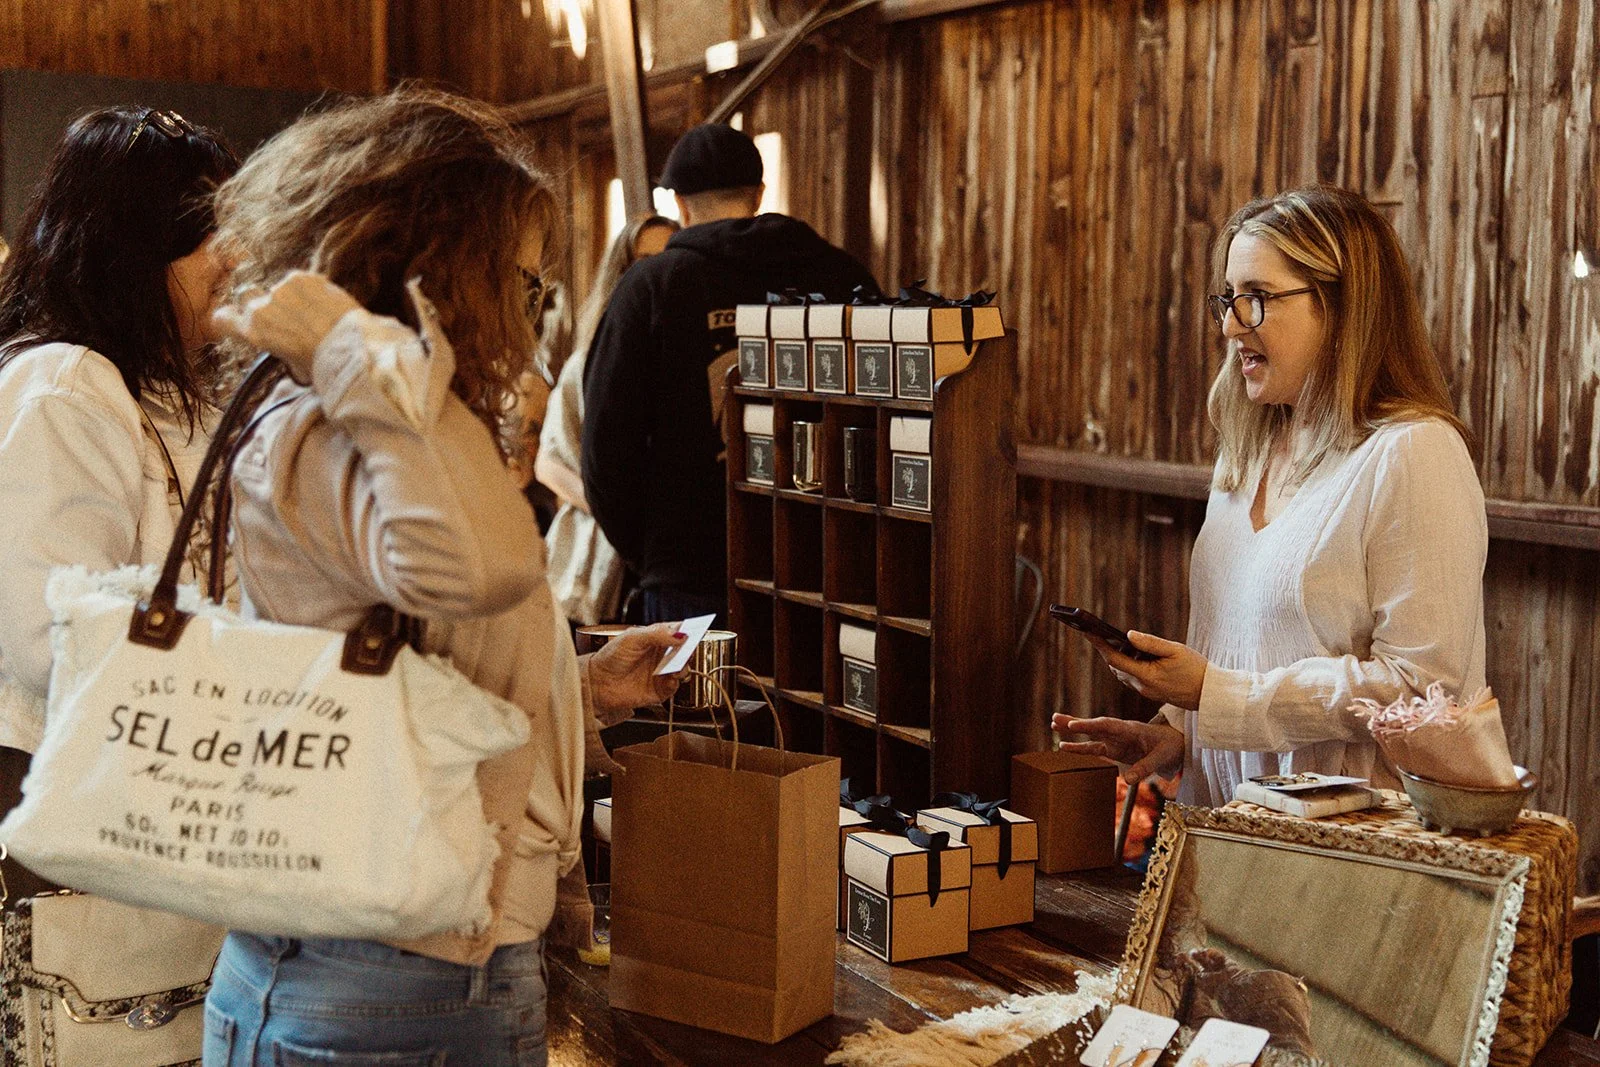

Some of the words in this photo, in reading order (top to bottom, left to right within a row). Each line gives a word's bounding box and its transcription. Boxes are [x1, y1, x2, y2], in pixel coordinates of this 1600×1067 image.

[133, 675, 176, 698] SAC
[193, 680, 226, 699] EN
[243, 688, 349, 723] LOCATION
[106, 704, 178, 757] SEL
[192, 730, 242, 768] de
[251, 730, 351, 770] MER
[170, 796, 246, 823] PARIS
